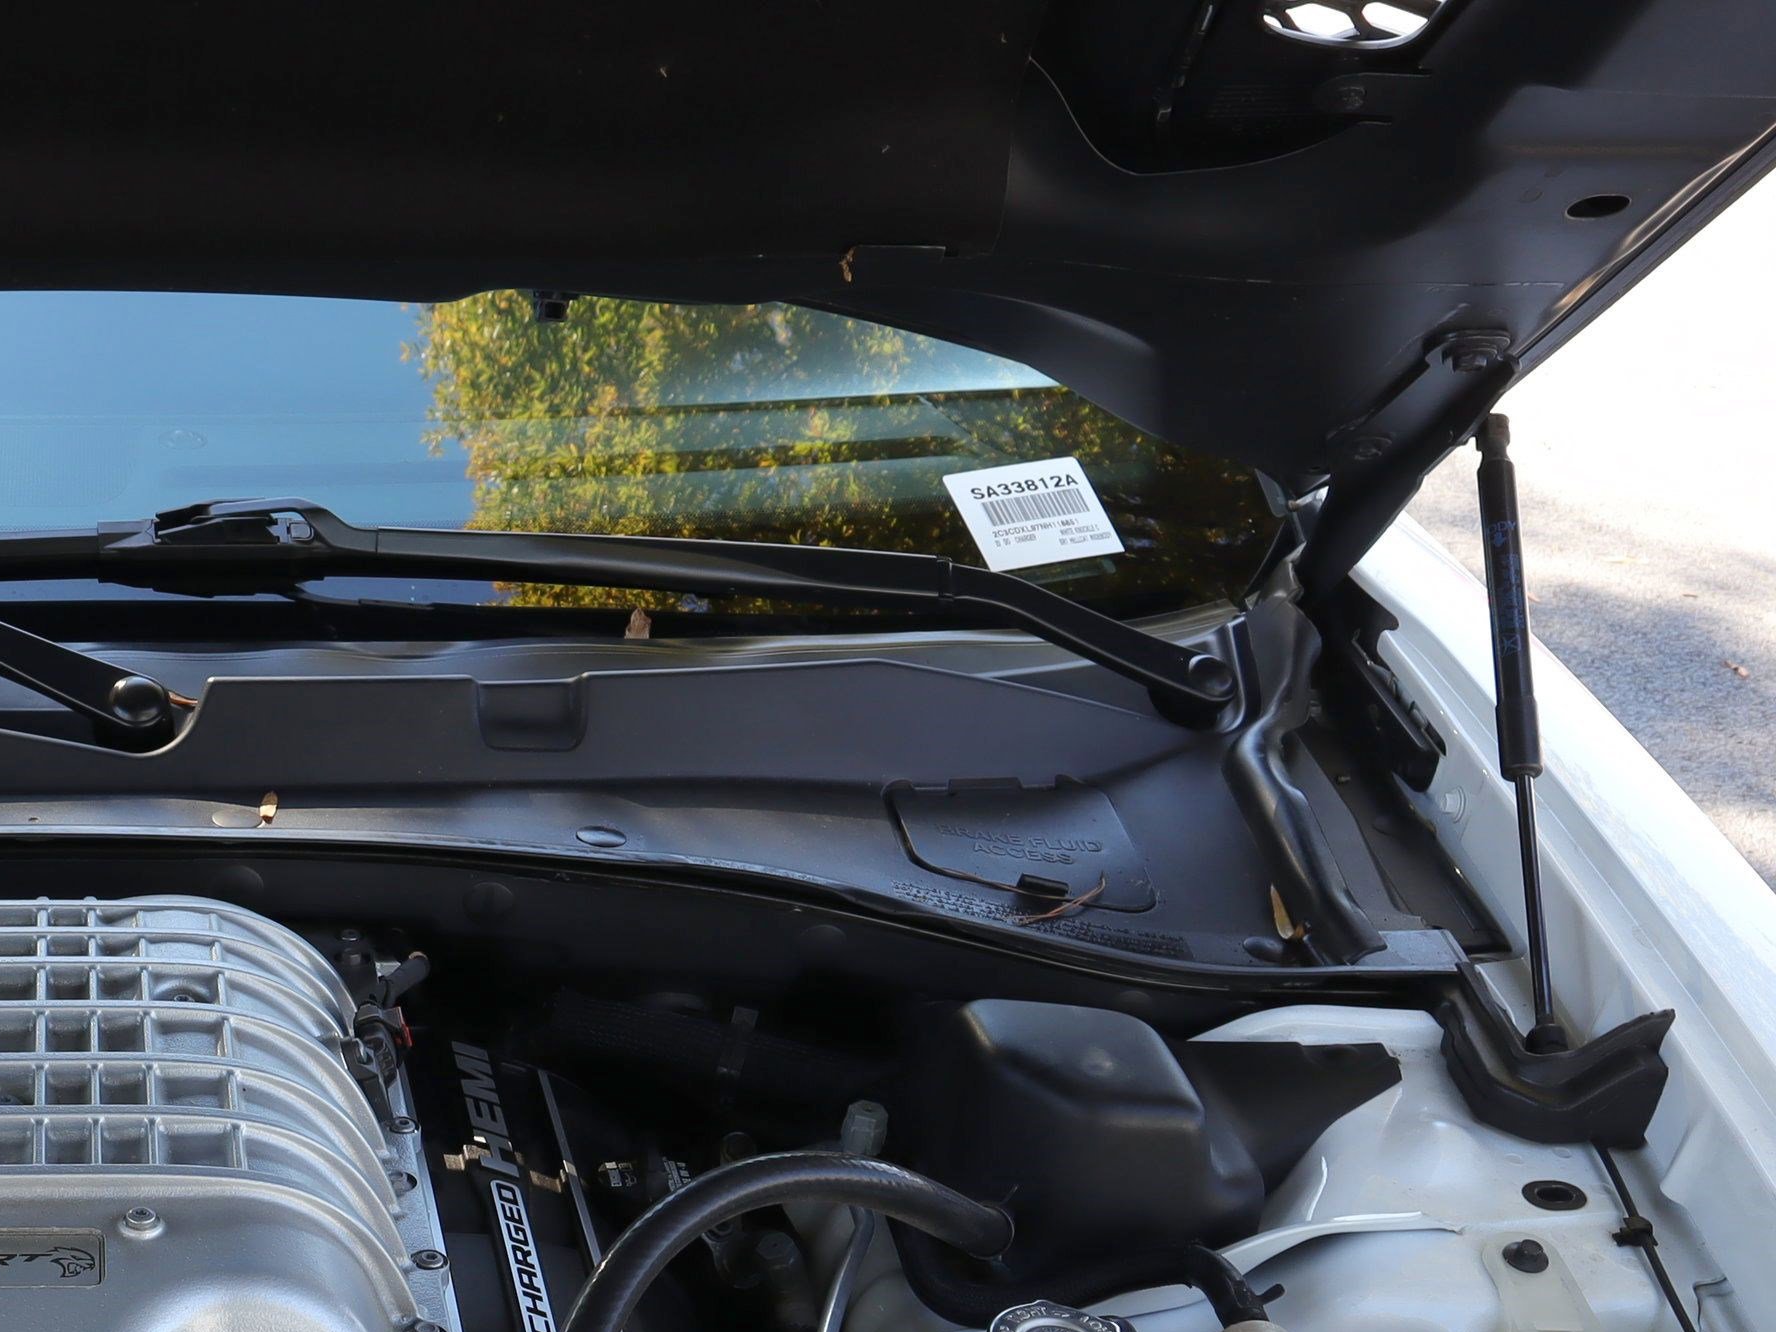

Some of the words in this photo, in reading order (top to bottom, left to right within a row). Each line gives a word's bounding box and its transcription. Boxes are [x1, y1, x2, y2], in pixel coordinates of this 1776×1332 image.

[971, 473, 1078, 500] SA33812A
[936, 823, 1022, 846] BRAKE
[1029, 836, 1103, 852] FLUID
[974, 843, 1074, 864] ACCESS
[451, 1041, 520, 1178] HEMI
